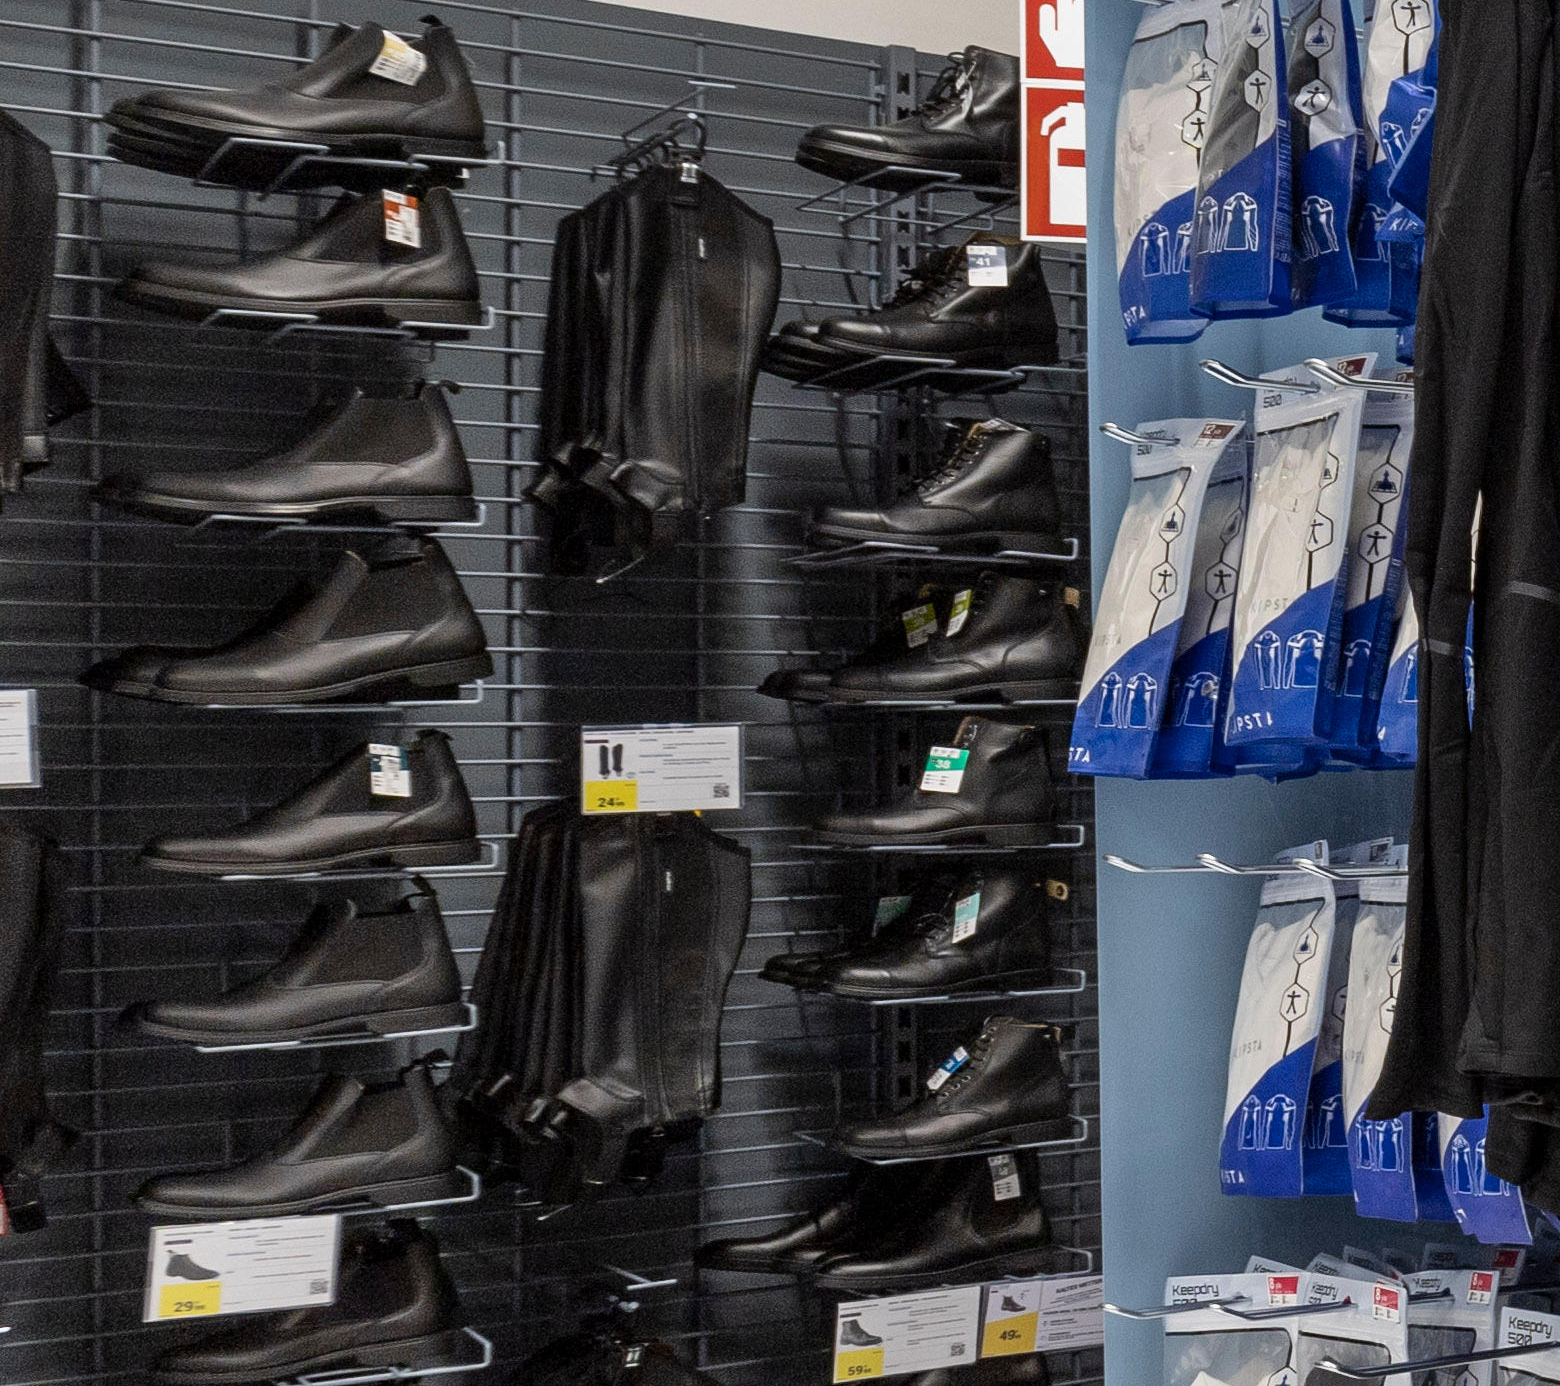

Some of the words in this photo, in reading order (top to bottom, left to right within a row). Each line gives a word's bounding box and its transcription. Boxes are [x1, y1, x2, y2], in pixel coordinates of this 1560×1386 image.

[1172, 1282, 1219, 1300] Keepdry
[173, 1301, 194, 1312] 29
[1508, 1315, 1552, 1339] Keepdry
[999, 1329, 1014, 1340] 49
[848, 1366, 863, 1376] 59
